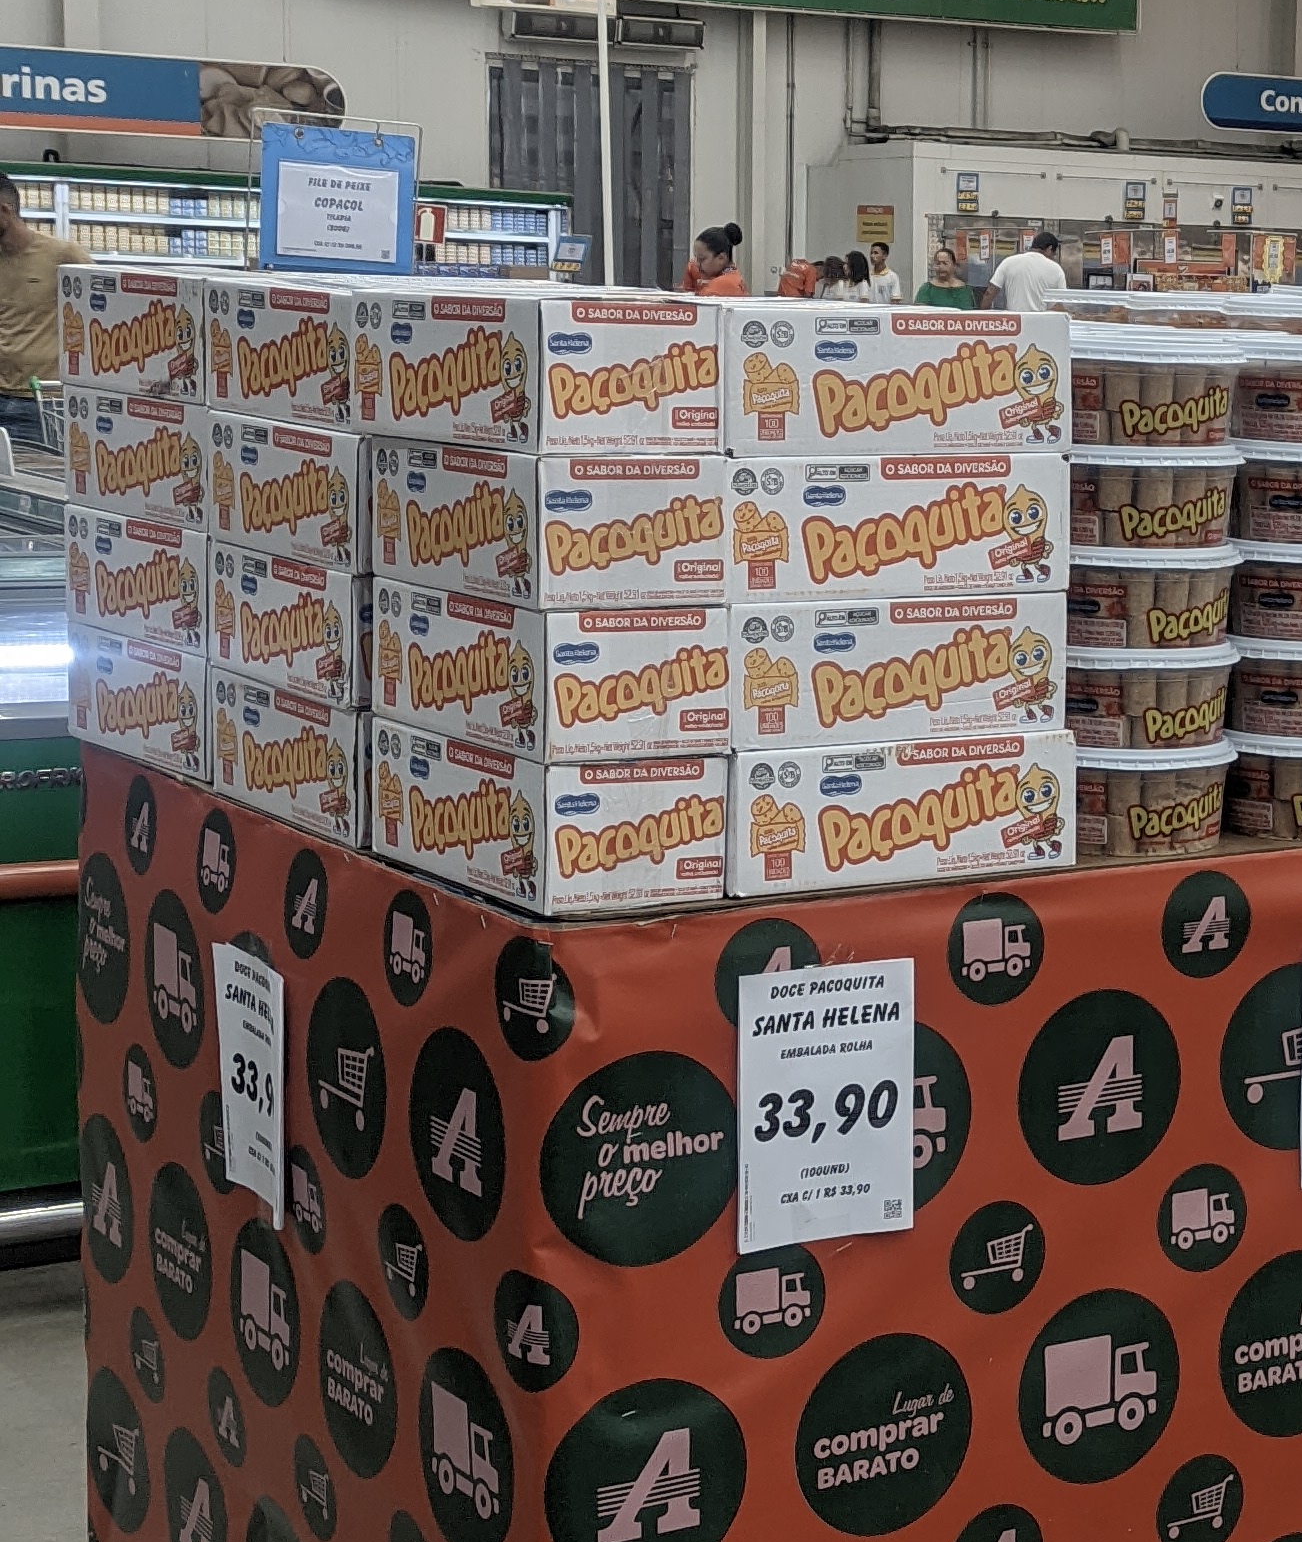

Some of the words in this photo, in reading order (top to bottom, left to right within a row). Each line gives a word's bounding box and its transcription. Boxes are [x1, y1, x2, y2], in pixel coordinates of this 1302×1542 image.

[314, 197, 364, 212] COPACOL
[588, 309, 622, 320] SABOR
[626, 310, 640, 321] DA
[642, 307, 694, 322] DIVERSÃO
[908, 318, 945, 331] SABOR
[948, 319, 963, 331] DA
[965, 316, 1018, 332] DIVERSÃO
[389, 326, 503, 421] Paçoquita
[549, 341, 720, 419] Paçoquita
[813, 340, 1017, 438] Paçoquita
[1119, 385, 1230, 437] Paçoquita
[546, 495, 723, 576] Paçoquita
[801, 482, 1008, 584] Paçoquita
[554, 645, 729, 728] Paçoquita
[812, 624, 1013, 728] Paçoquita
[555, 794, 725, 879] Paçoquita
[818, 763, 1021, 872] Paçoquita
[225, 983, 257, 1012] SANTA
[770, 982, 806, 1000] DOCE
[809, 975, 885, 996] PACOQUITA
[752, 1010, 816, 1038] SANTA
[822, 1001, 901, 1028] HELENA
[780, 1043, 837, 1061] EMBALADA
[839, 1039, 873, 1055] ROLHA
[576, 1095, 671, 1142] Sempre
[754, 1079, 899, 1144] 33,90
[598, 1142, 619, 1168] o
[623, 1129, 725, 1165] melhor
[800, 1162, 850, 1180] (100UND)
[577, 1166, 664, 1220] preço
[780, 1191, 799, 1205] CXA
[801, 1188, 814, 1202] C/
[823, 1185, 837, 1199] R$
[839, 1182, 871, 1198] 33,90
[892, 1391, 934, 1418] Lugar
[931, 1383, 954, 1406] de
[813, 1411, 945, 1462] comprar
[817, 1447, 920, 1490] BARATO
